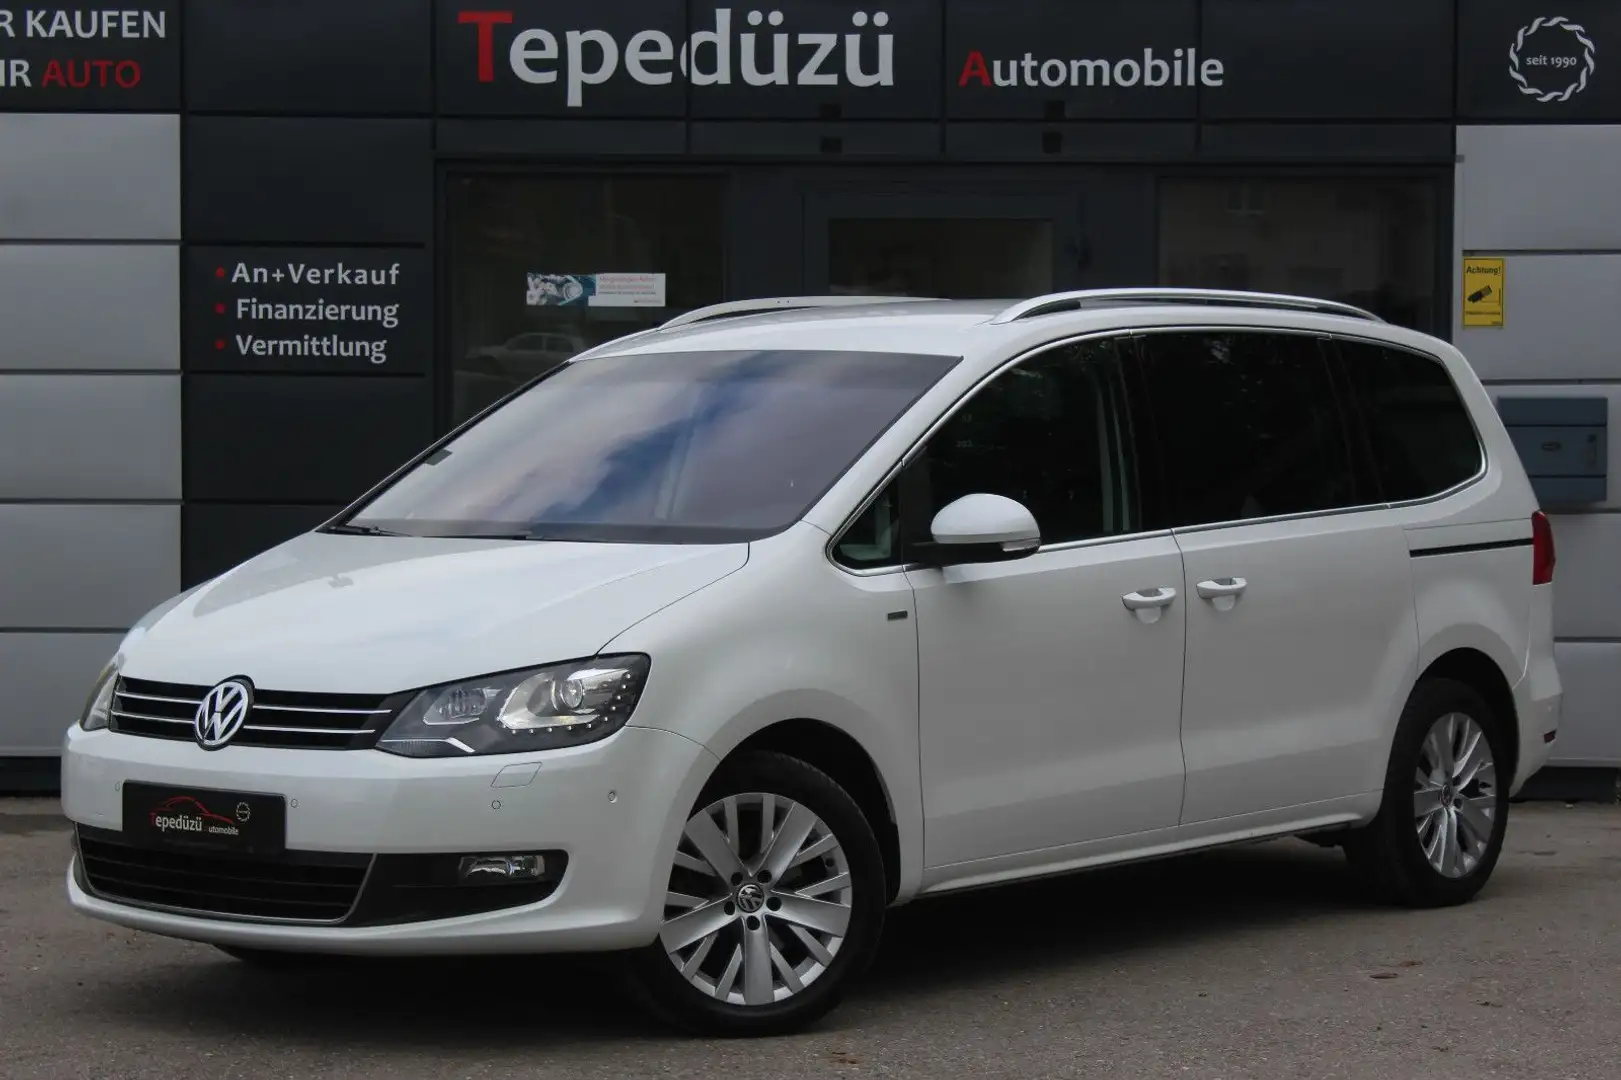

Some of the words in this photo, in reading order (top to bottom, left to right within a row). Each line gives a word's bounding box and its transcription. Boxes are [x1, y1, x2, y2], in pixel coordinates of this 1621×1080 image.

[26, 9, 166, 39] KAUFEN
[458, 8, 894, 107] Tepedüzü
[959, 48, 1224, 87] Automobile
[1526, 54, 1548, 66] seit
[1550, 56, 1577, 69] 1990
[0, 59, 32, 87] R
[42, 59, 141, 88] AUTO
[231, 262, 400, 286] An+Verkauf
[1466, 266, 1501, 276] Achtung!
[236, 298, 400, 328] Finanzierung
[235, 334, 388, 364] Vermittlung
[150, 812, 203, 833] Tepedüzü
[204, 824, 240, 836] utomobile
